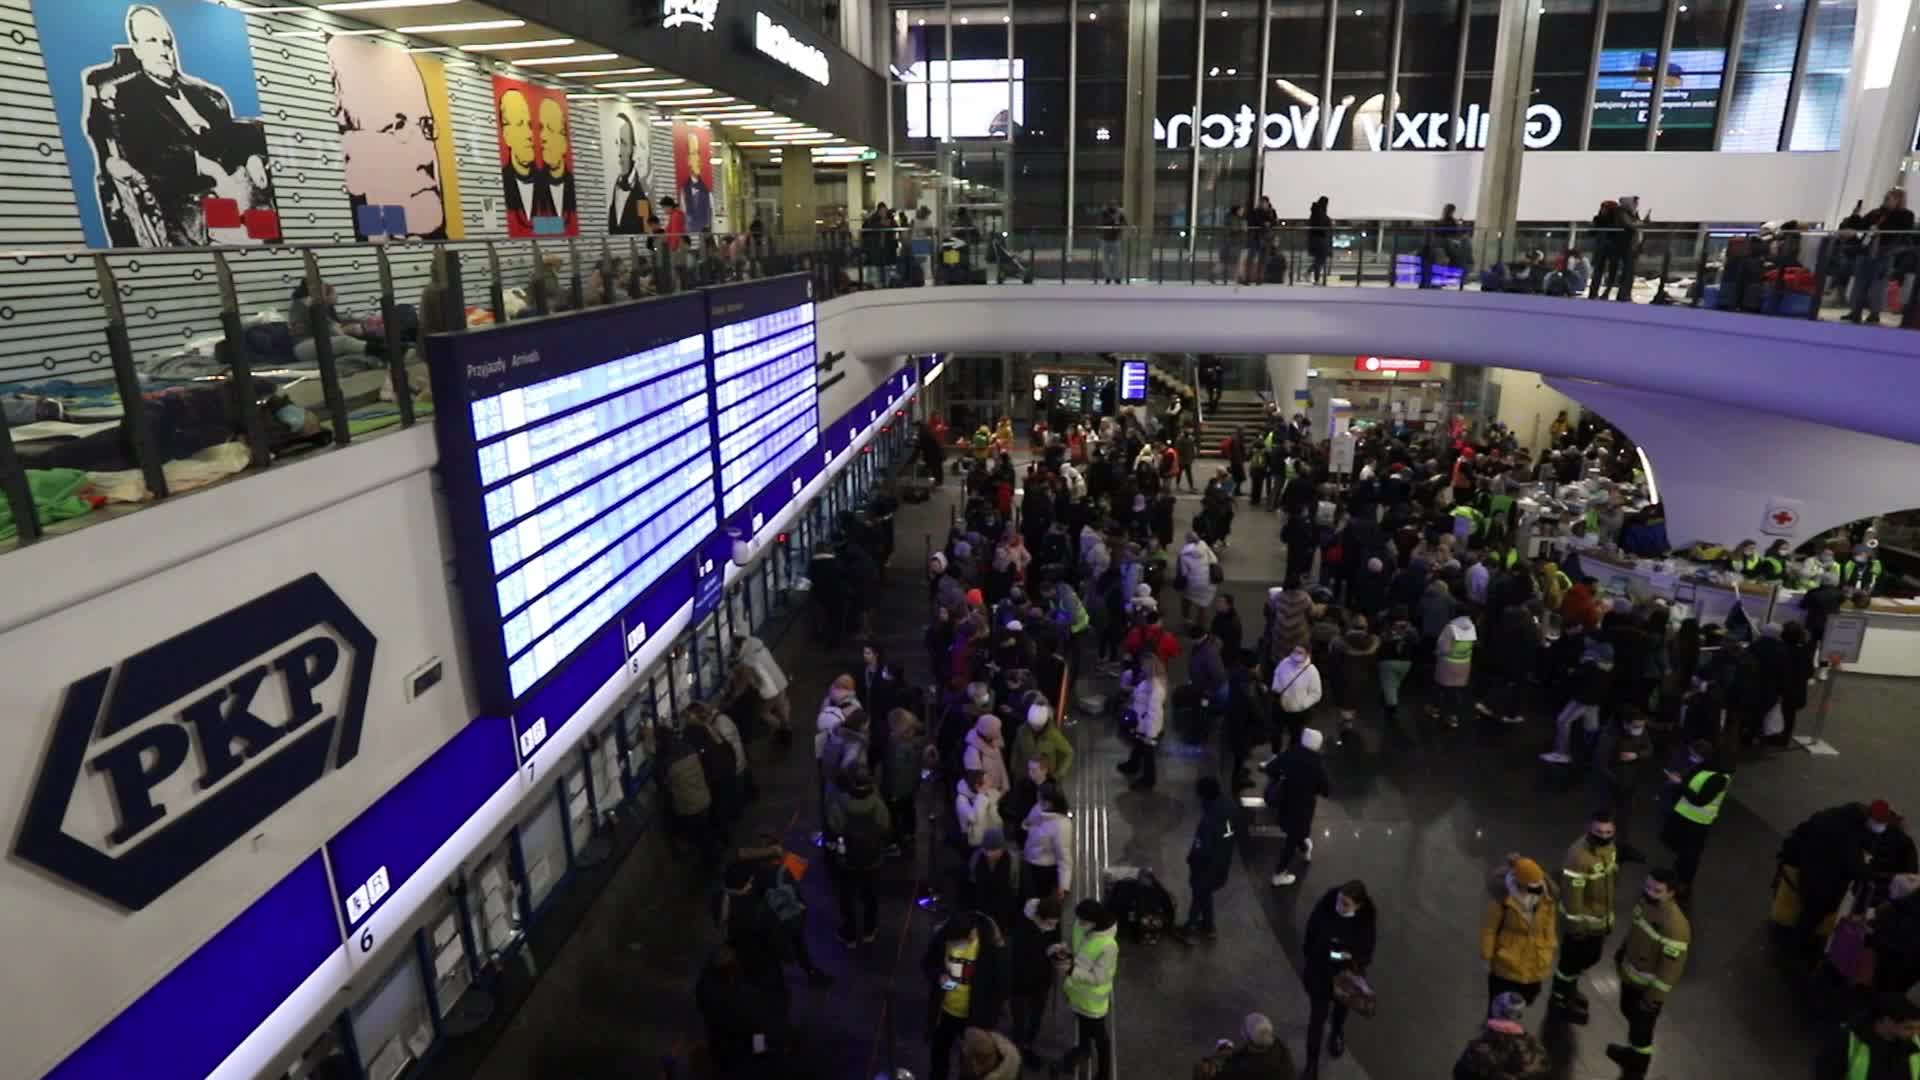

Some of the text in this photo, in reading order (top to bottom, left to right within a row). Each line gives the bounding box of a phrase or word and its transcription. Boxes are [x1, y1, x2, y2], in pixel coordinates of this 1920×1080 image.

[87, 637, 339, 845] PKP
[528, 762, 535, 781] 7
[360, 927, 374, 953] 6
